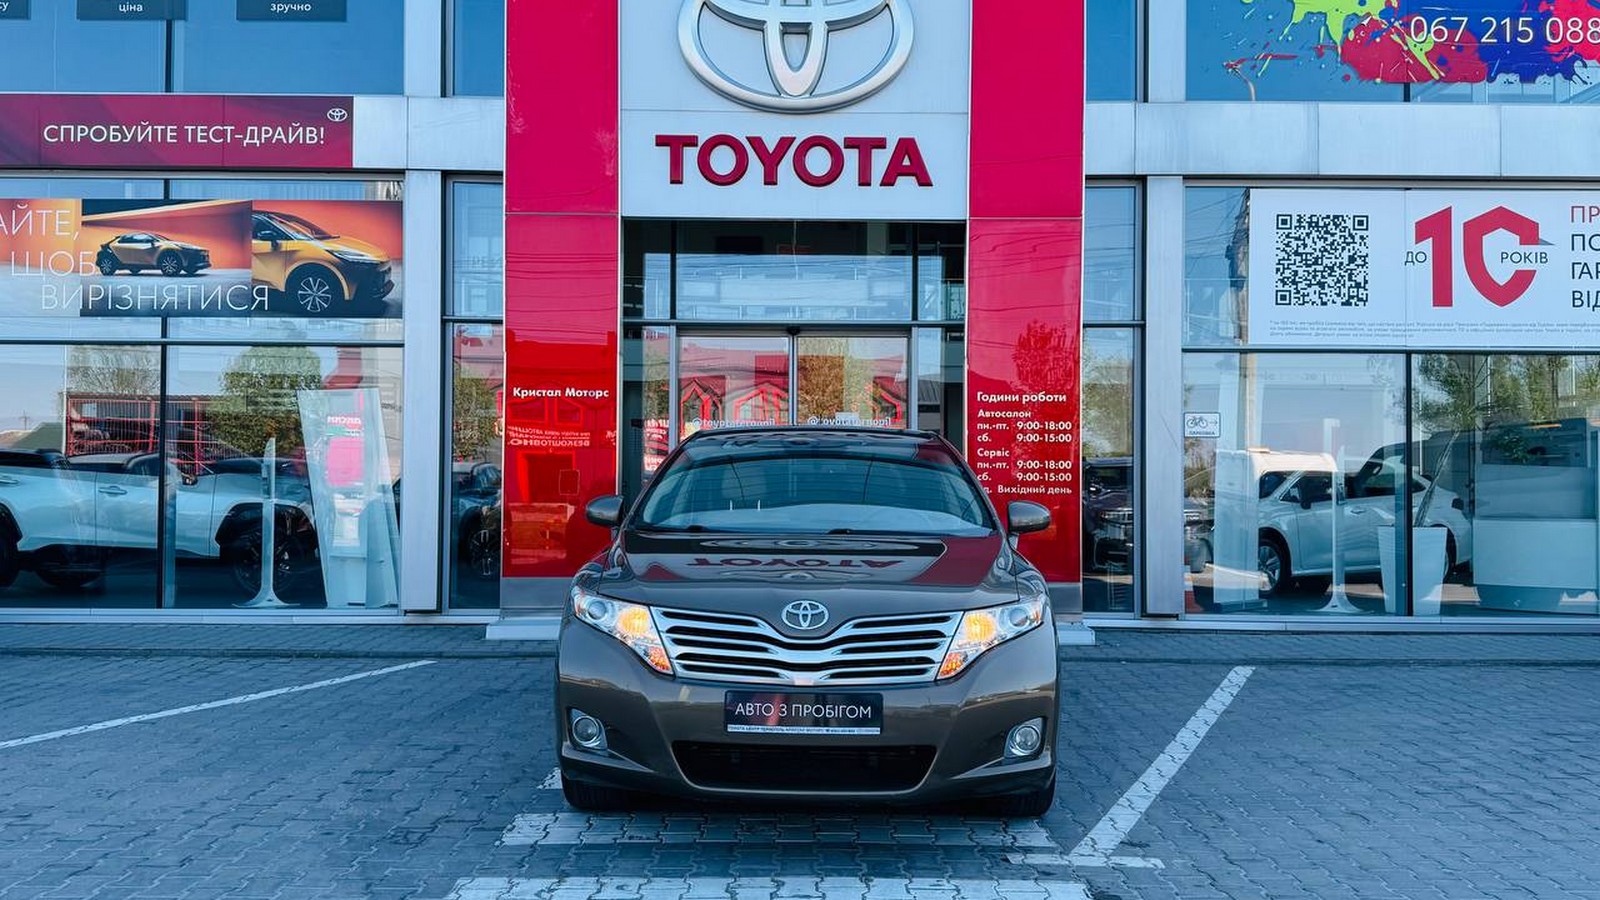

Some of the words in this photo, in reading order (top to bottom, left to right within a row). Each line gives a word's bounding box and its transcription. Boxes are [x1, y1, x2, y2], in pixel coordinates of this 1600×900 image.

[119, 3, 143, 12] ціна
[270, 4, 312, 13] зручно
[1411, 17, 1467, 43] 067
[1481, 17, 1533, 43] 215
[1546, 17, 1600, 43] 088
[43, 121, 178, 143] СПРОБУЙТЕ
[184, 123, 325, 147] ТЕСТ-ДРАЙВ!
[655, 134, 933, 187] TOYOTA
[1405, 251, 1427, 266] ДО
[1500, 251, 1549, 264] РОКІВ
[11, 251, 96, 281] ЩОБ
[42, 285, 269, 311] ВИРІЗНЯТИСЯ
[513, 387, 561, 399] Кристал
[565, 387, 609, 399] Моторс
[977, 392, 1019, 402] Години
[1022, 391, 1066, 404] роботи
[977, 409, 1031, 418] Автосалон
[1016, 421, 1072, 430] 9:00-18:00
[977, 433, 992, 442] сб.
[1016, 433, 1072, 442] 9:00-15:00
[977, 448, 1010, 458] Сервіс
[1016, 460, 1072, 469] 9:00-18:00
[977, 473, 992, 481] сб.
[1016, 472, 1072, 481] 9:00-15:00
[997, 484, 1046, 494] Вихідний
[1047, 487, 1073, 495] день
[735, 703, 774, 716] АВТО
[779, 705, 787, 716] З
[792, 705, 871, 718] ПРОБІГОМ
